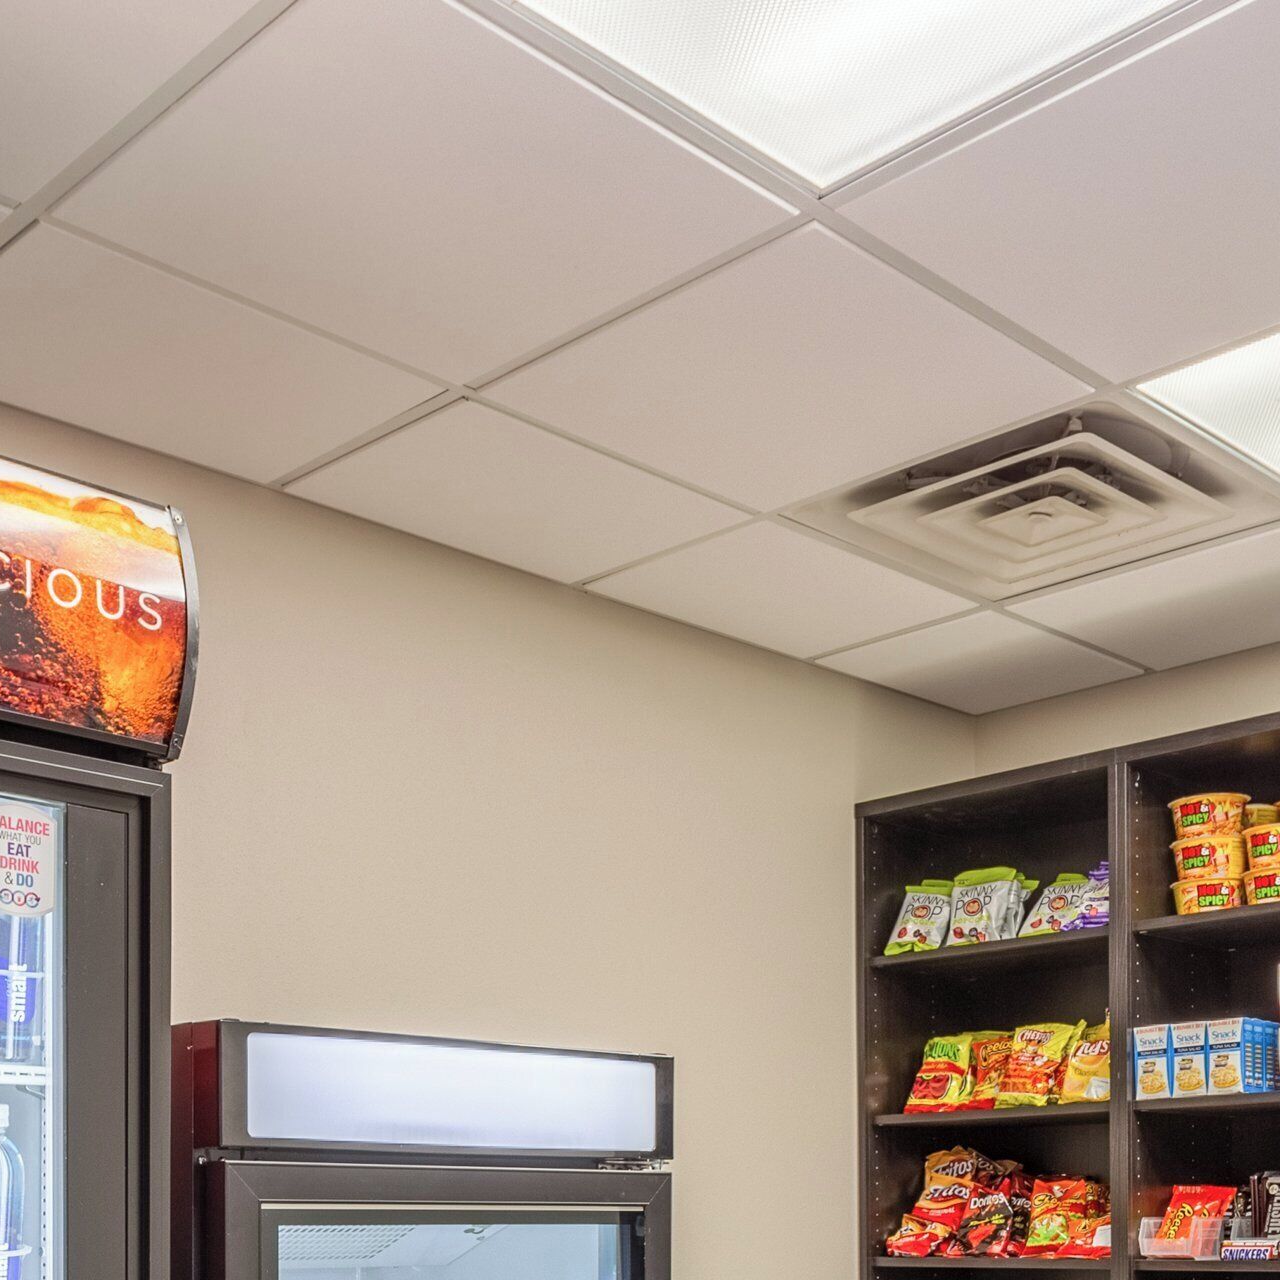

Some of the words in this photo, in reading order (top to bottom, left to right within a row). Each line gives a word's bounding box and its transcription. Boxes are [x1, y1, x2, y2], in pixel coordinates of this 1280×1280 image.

[1180, 802, 1200, 815] HOT
[1182, 813, 1209, 827] SPICY
[25, 834, 41, 846] YOU
[7, 841, 31, 858] EAT
[1253, 844, 1277, 857] SPICY
[0, 855, 40, 874] DRINK
[1184, 856, 1210, 870] SPICY
[4, 871, 13, 885] &
[16, 872, 34, 888] DO
[960, 885, 997, 899] SKINNY
[1046, 884, 1083, 895] SKINNY
[912, 895, 945, 905] SKINNY
[955, 897, 992, 917] POP
[1038, 895, 1077, 912] POP
[1199, 894, 1229, 907] SPICY
[902, 904, 942, 921] POP
[1140, 1036, 1164, 1046] Snack
[1176, 1033, 1200, 1042] Snack
[1212, 1030, 1237, 1039] Snack
[1223, 1247, 1269, 1261] SNICKERS
